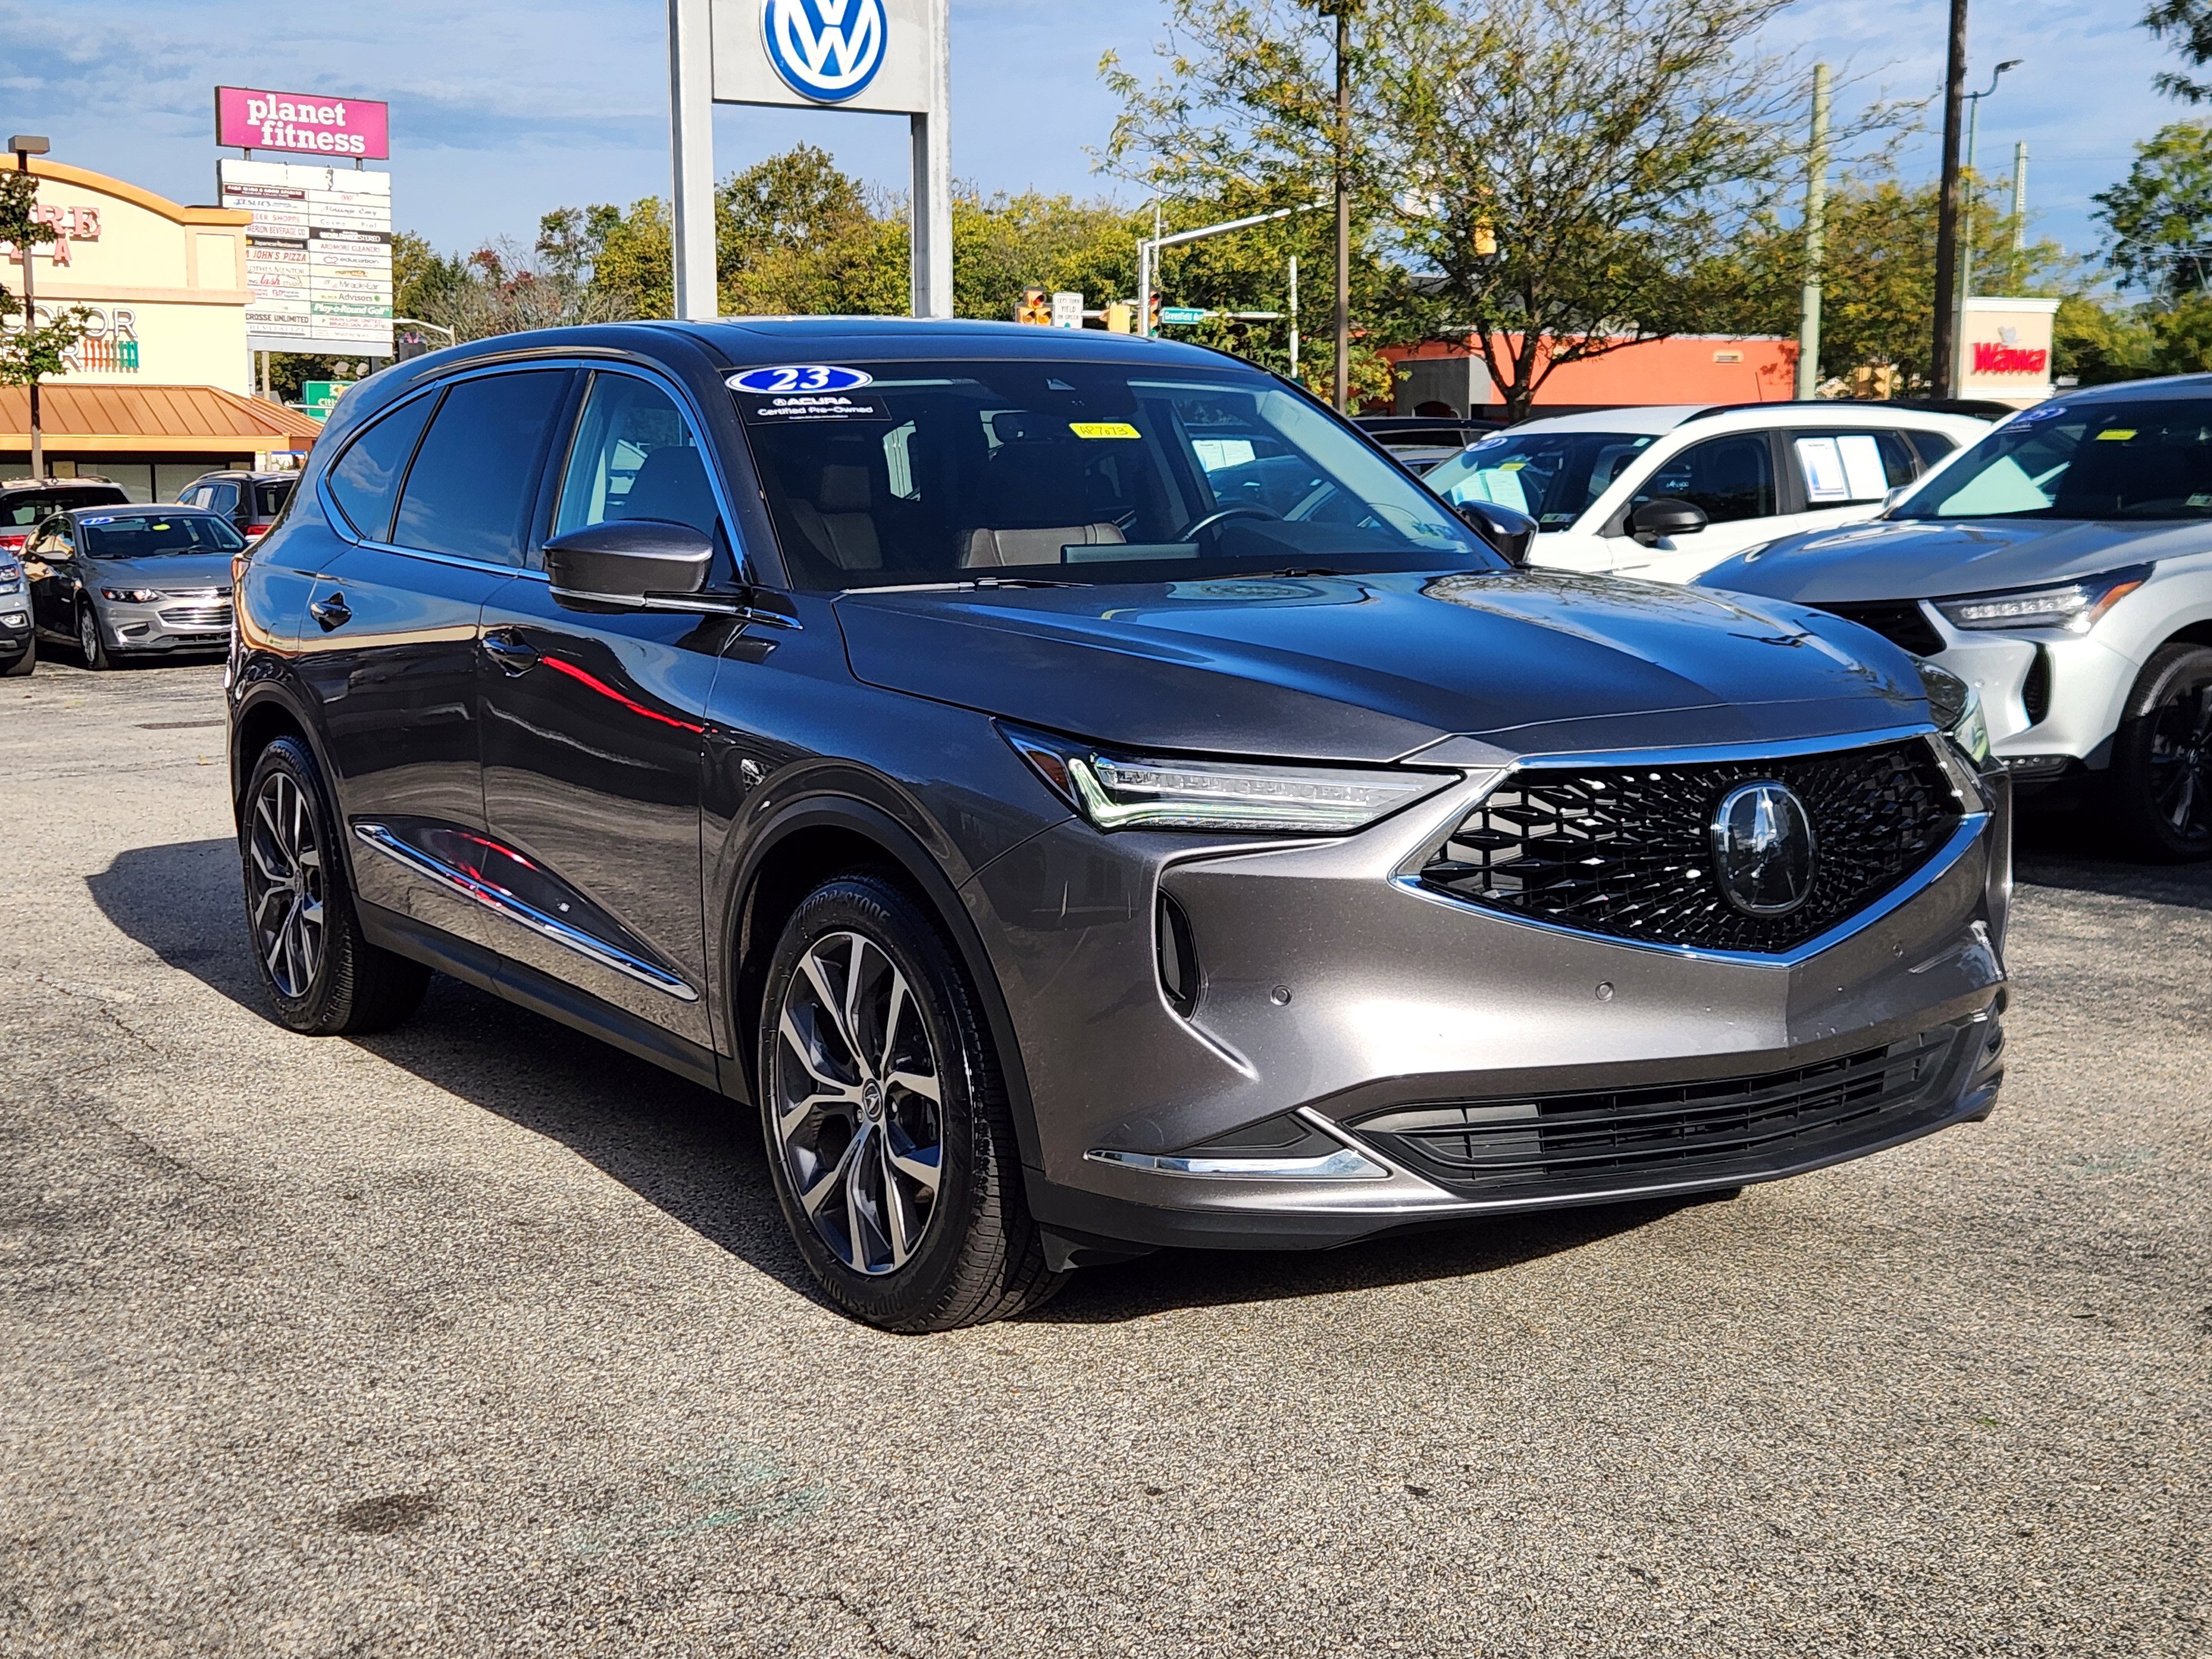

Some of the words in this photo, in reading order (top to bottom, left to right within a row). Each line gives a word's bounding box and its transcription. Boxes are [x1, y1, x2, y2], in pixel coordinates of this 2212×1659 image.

[247, 93, 346, 127] planet
[261, 121, 366, 154] fitness
[273, 215, 300, 223] SHOPPE
[253, 250, 280, 260] JOHN'S
[283, 252, 306, 262] PIZZA
[338, 293, 373, 302] Advisors
[368, 306, 387, 315] Golf
[274, 314, 309, 324] UNLIMITED
[1973, 342, 2046, 373] Wawa
[767, 367, 831, 391] 23
[787, 397, 852, 406] ACURA
[757, 407, 807, 416] Certified
[808, 405, 874, 414] Pre-Owned
